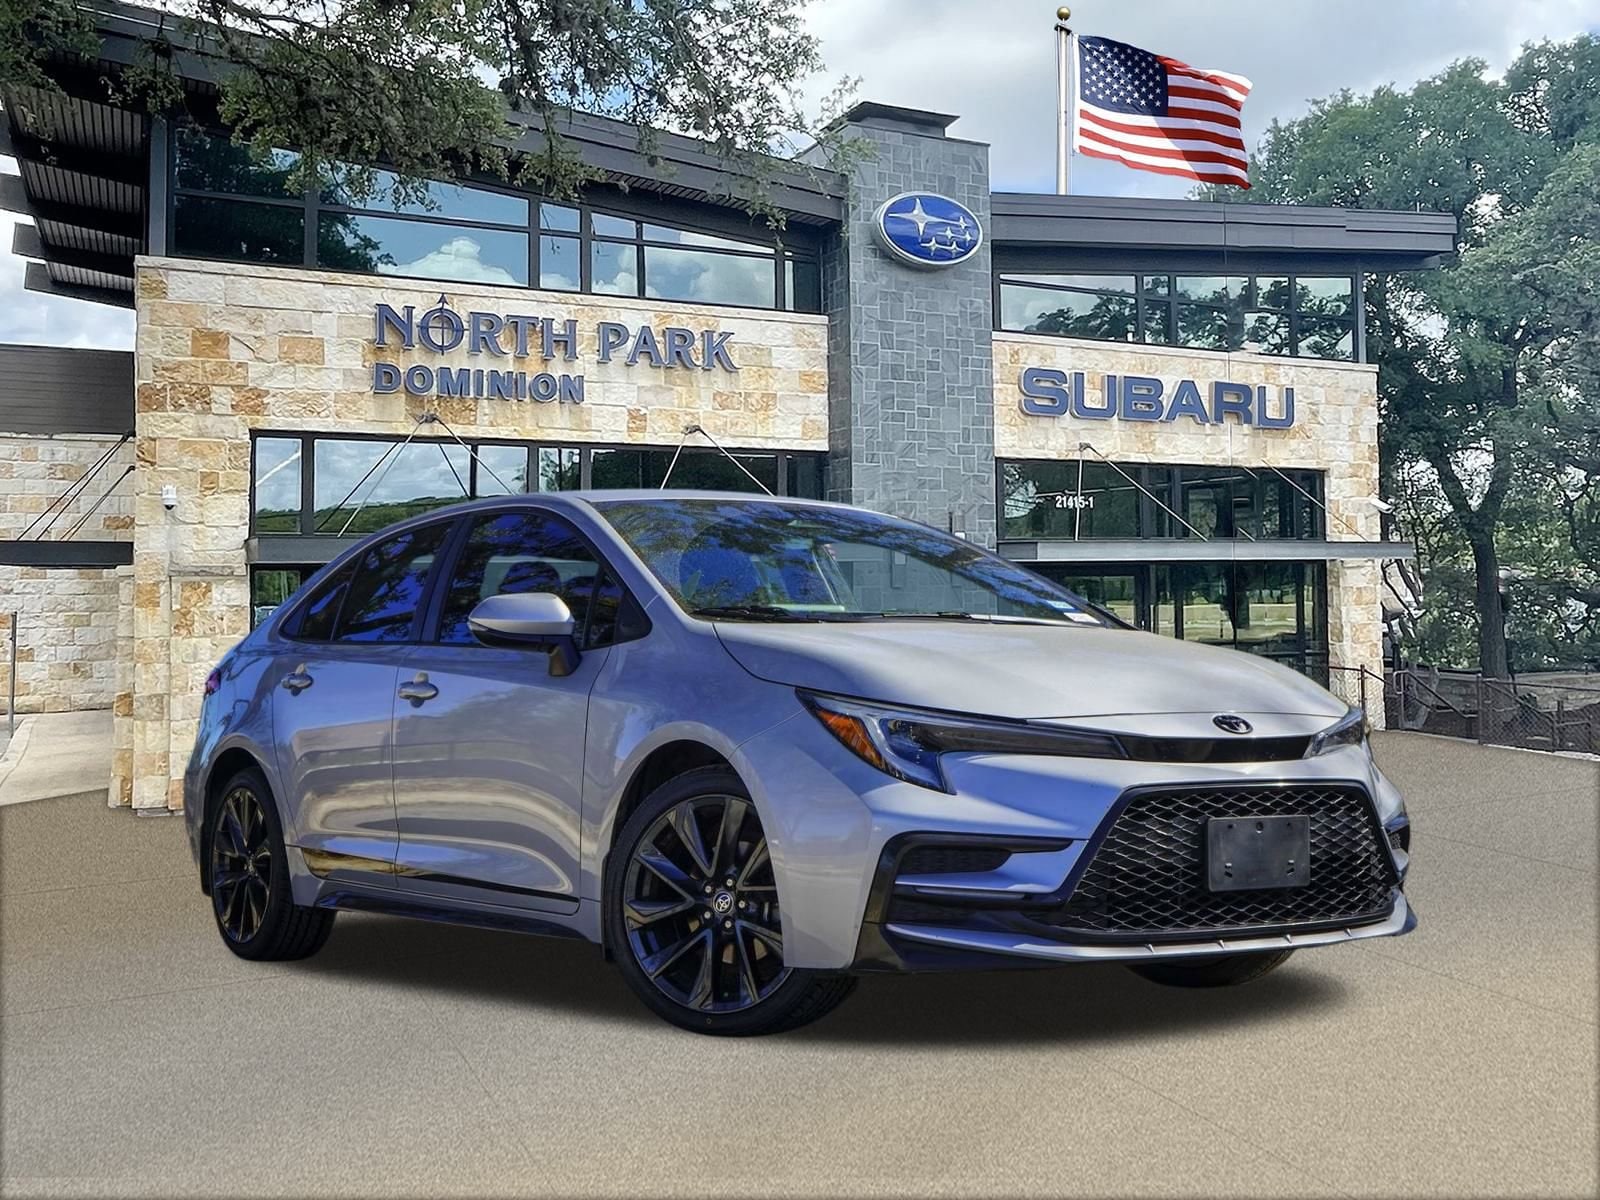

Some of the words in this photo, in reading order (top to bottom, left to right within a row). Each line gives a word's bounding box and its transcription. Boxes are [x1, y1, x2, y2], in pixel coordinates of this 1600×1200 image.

[374, 301, 579, 362] NORTH
[596, 321, 742, 373] PARK
[373, 362, 585, 404] DOMINION
[1019, 367, 1295, 430] SUBARU
